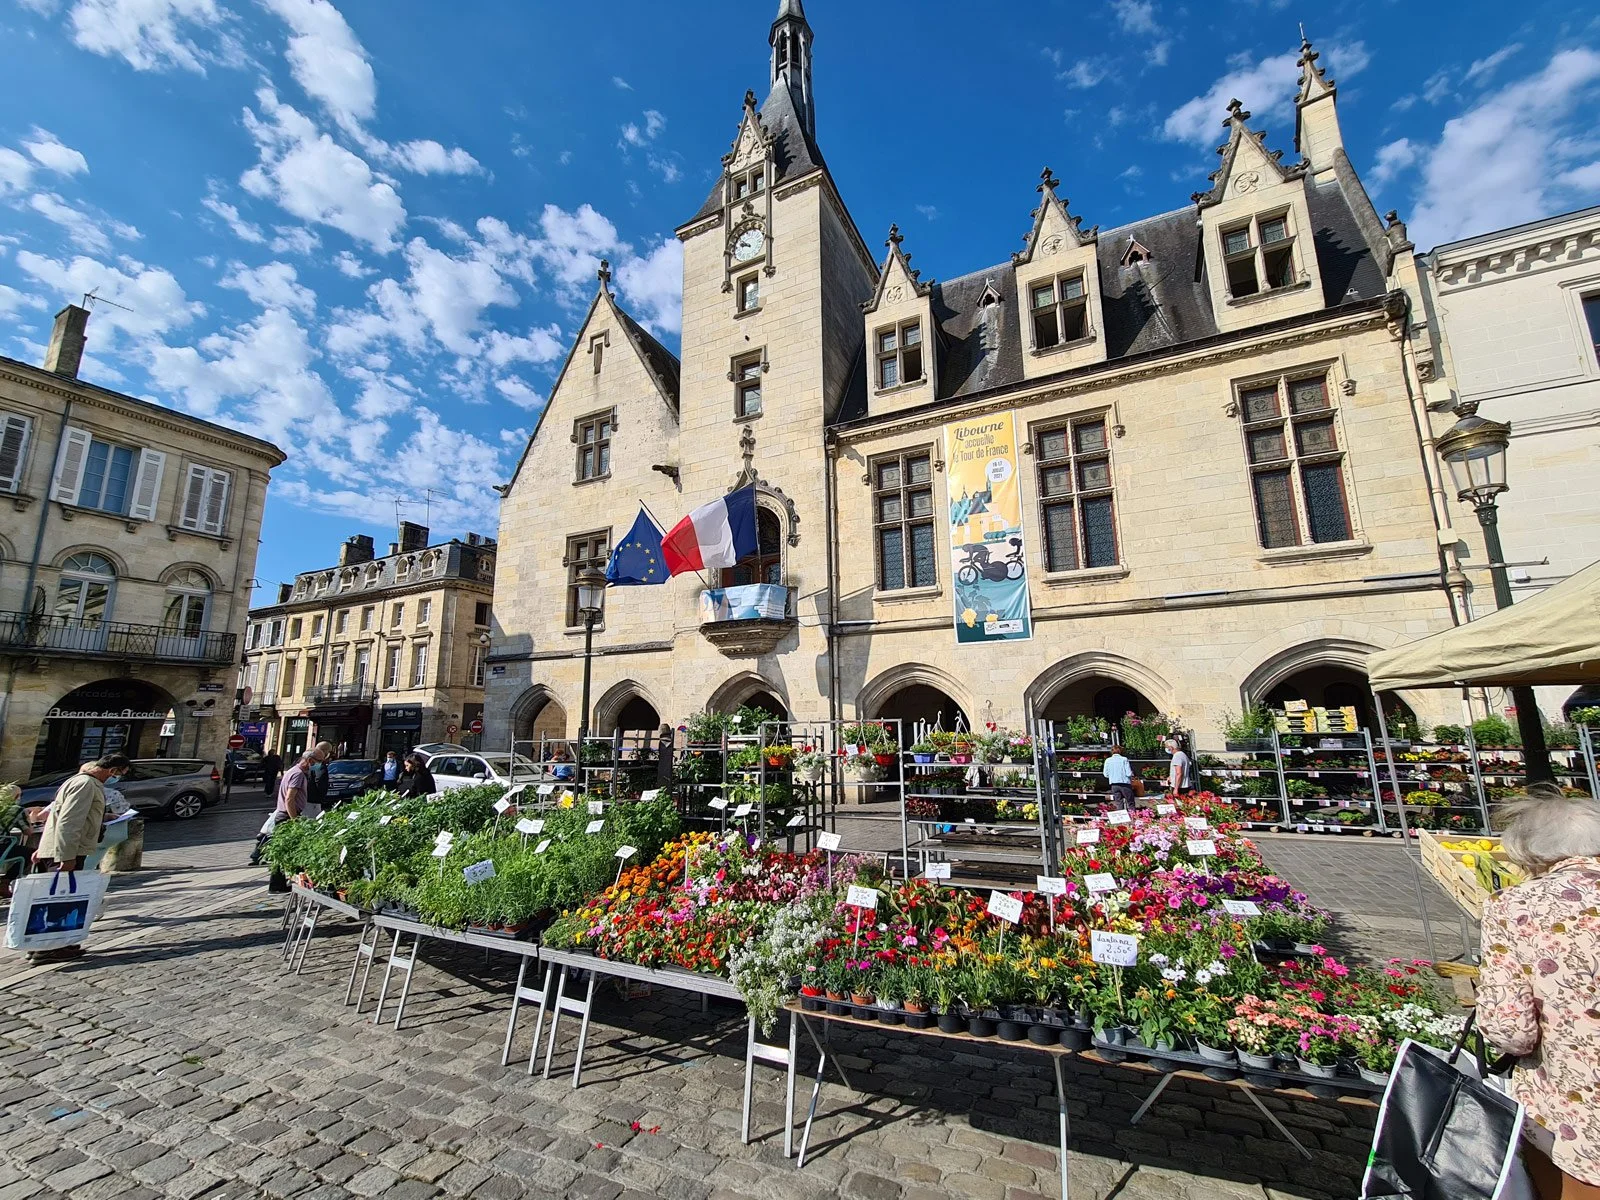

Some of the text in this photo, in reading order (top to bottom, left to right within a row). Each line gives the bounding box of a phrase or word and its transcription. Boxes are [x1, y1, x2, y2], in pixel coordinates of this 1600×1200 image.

[954, 421, 1004, 441] Libourne
[960, 449, 975, 461] Tour
[976, 446, 985, 458] de
[985, 444, 1008, 457] France
[49, 707, 166, 718] Agence des Arcades
